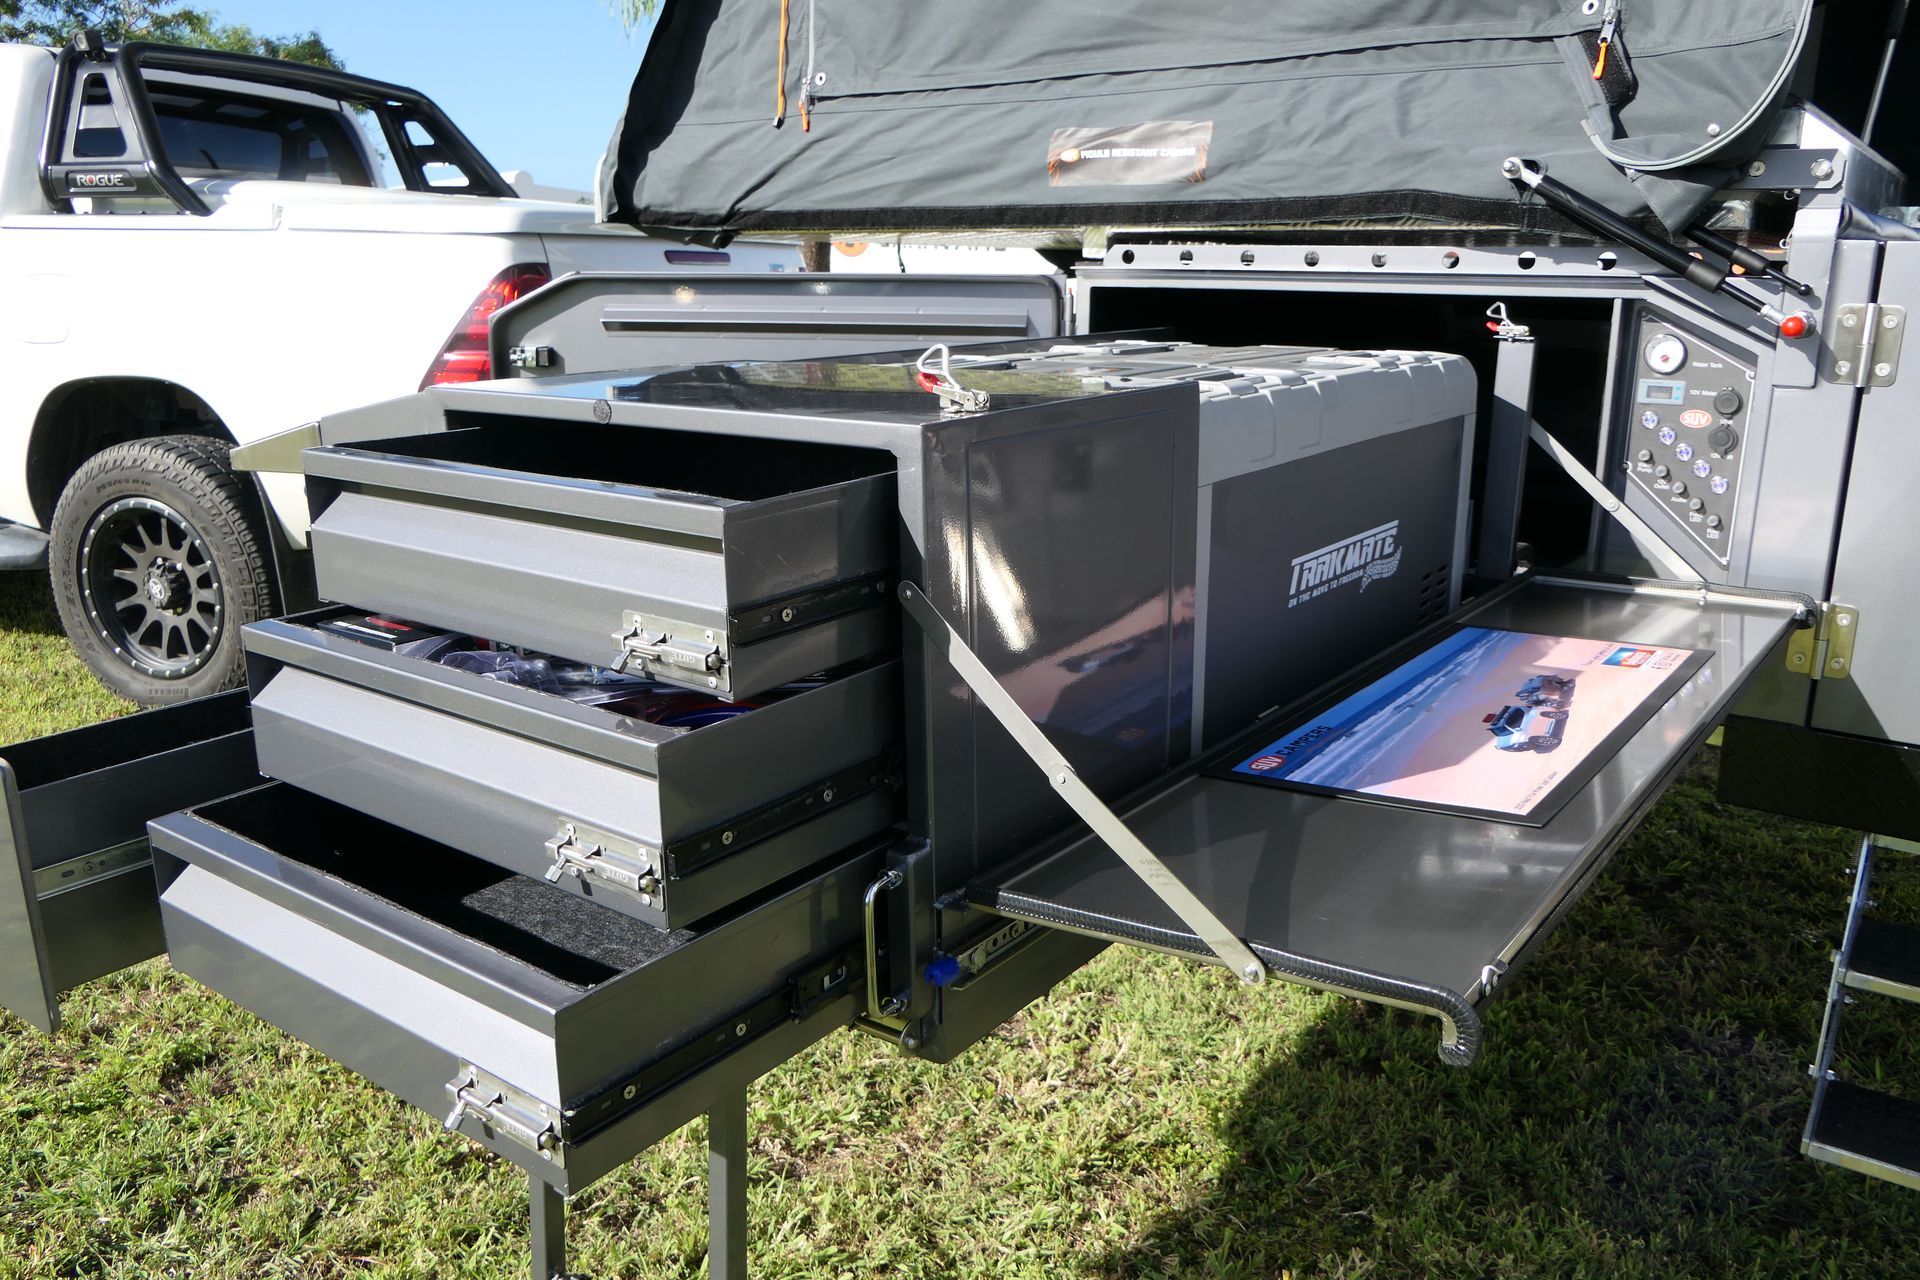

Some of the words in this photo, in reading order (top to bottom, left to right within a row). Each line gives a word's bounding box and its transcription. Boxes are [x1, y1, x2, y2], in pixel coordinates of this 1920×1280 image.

[76, 174, 124, 186] ROGUE
[1684, 414, 1708, 425] SUV
[1288, 596, 1298, 608] ON
[1299, 591, 1312, 604] THE
[1312, 583, 1329, 598] MOVE
[1330, 579, 1338, 590] TO
[1338, 569, 1364, 586] FREEDOM
[1250, 756, 1283, 771] SUV
[1275, 725, 1333, 756] CAMPERS
